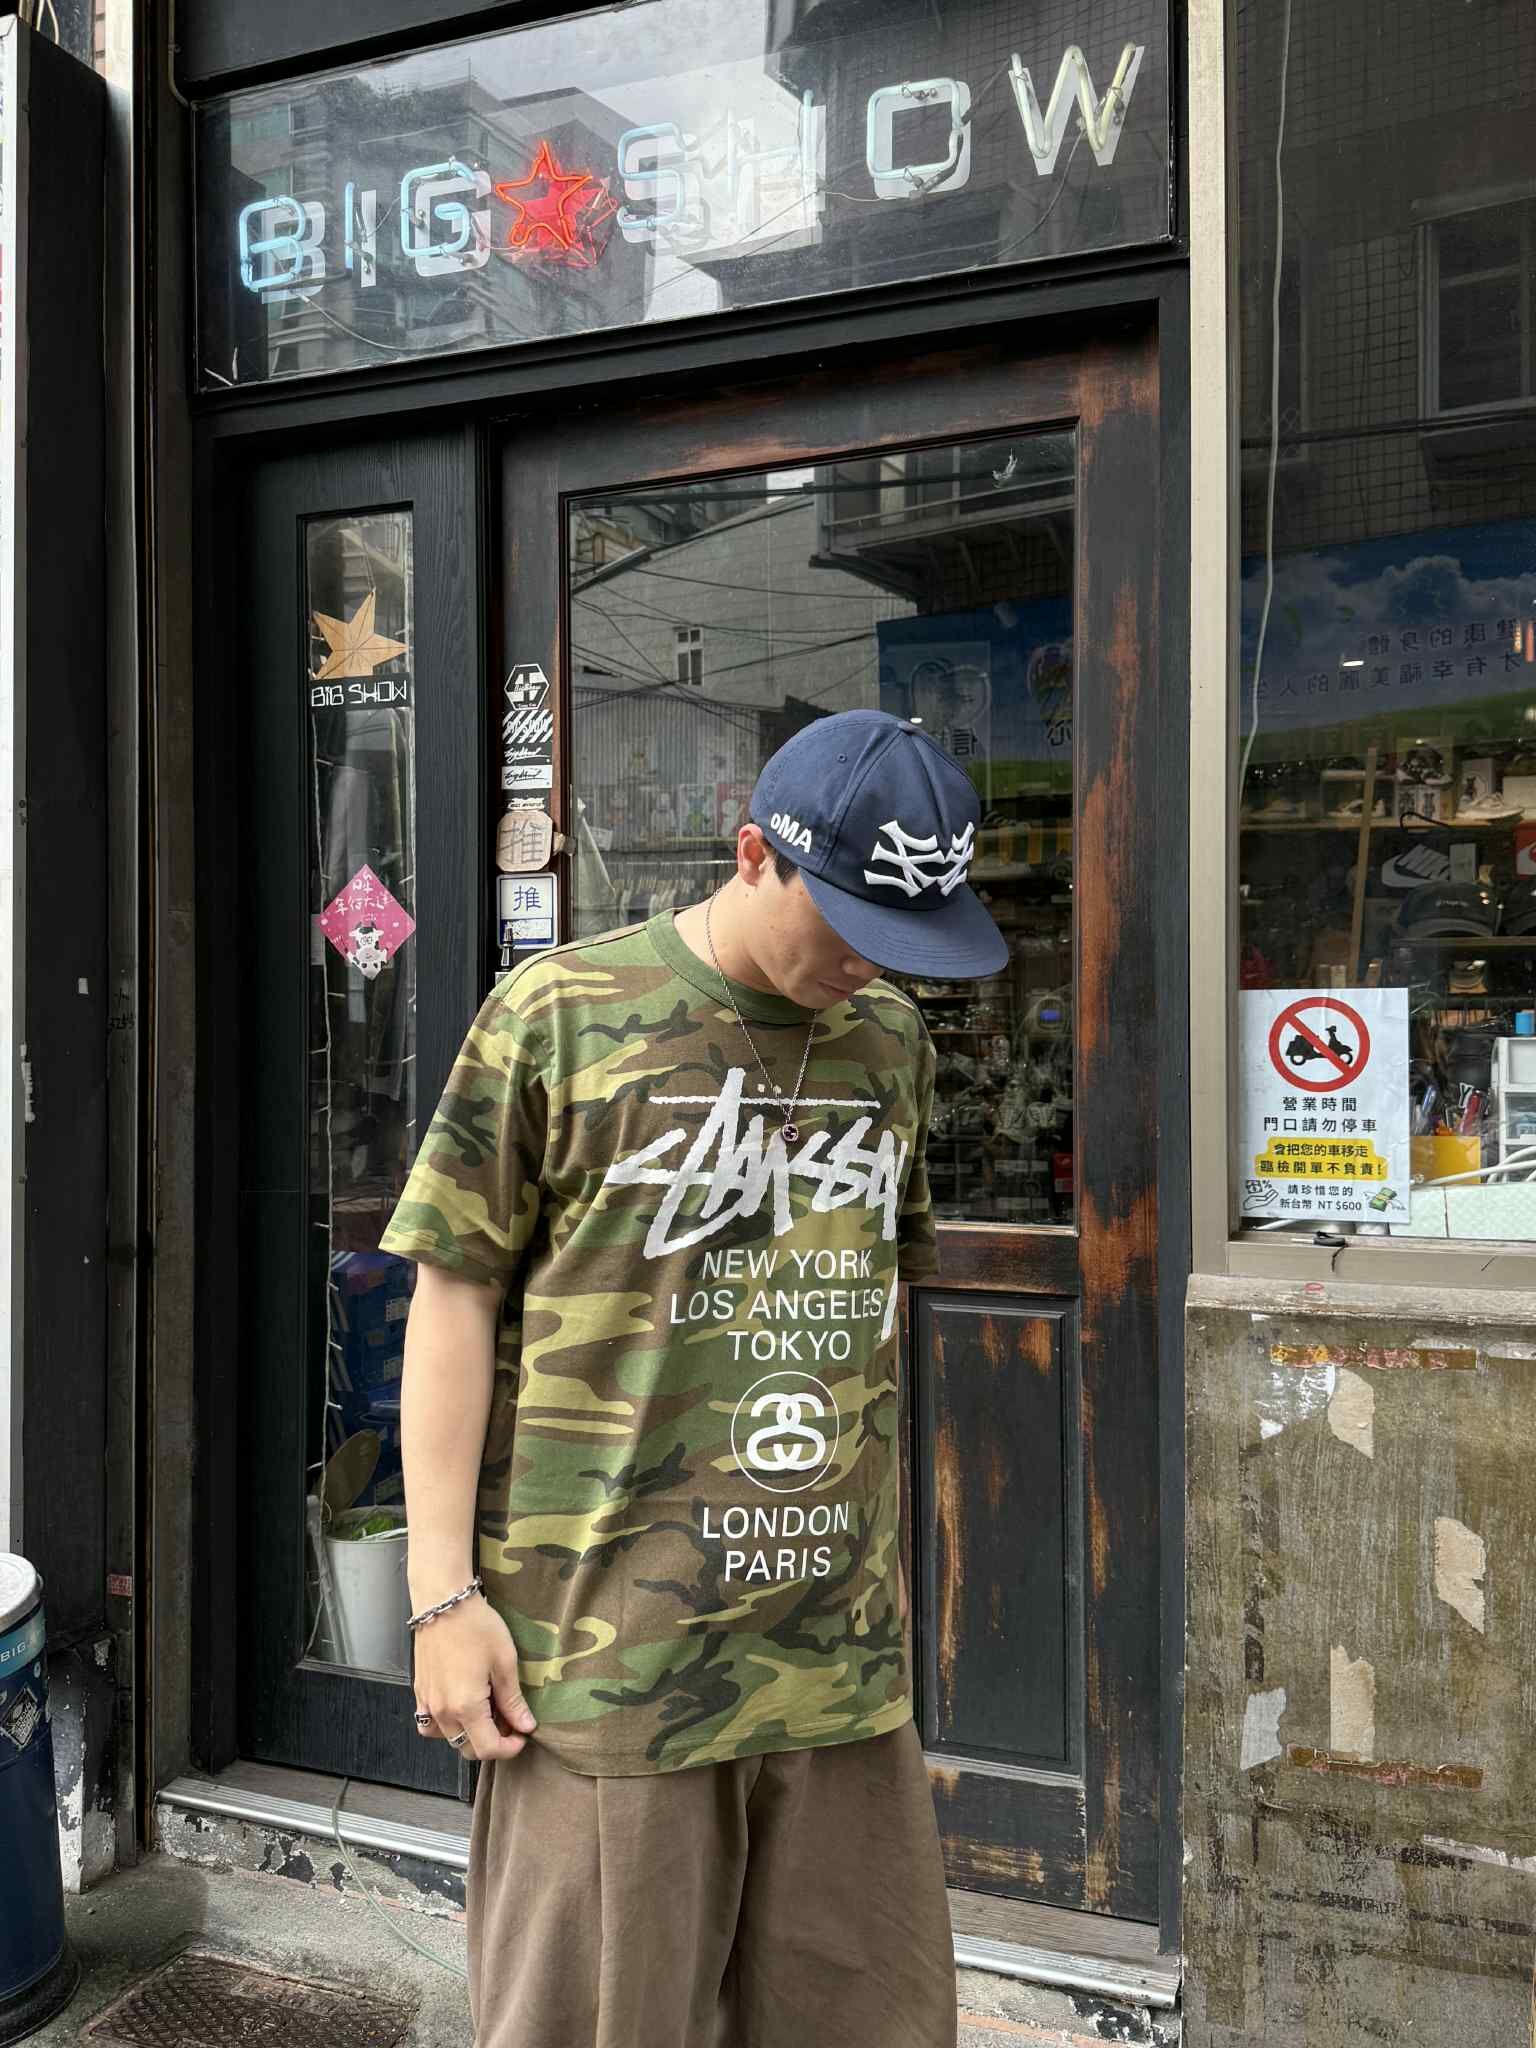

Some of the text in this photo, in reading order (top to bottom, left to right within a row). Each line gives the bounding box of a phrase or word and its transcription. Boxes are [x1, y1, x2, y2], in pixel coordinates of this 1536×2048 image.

[239, 42, 1145, 304] BIG SHOW
[349, 680, 407, 704] SHOW
[514, 886, 542, 911] 推
[1283, 1097, 1357, 1112] 營業時間
[1264, 1117, 1377, 1132] 門口請勿停車
[1274, 1144, 1368, 1157] 會把您的車移走
[1287, 1184, 1353, 1197] 請珍惜您的
[1280, 1199, 1362, 1211] 新台幣 NT $600
[702, 1249, 872, 1280] NEW YORK
[670, 1288, 883, 1324] LOS ANGELES
[727, 1330, 851, 1361] TOKYO
[702, 1501, 849, 1539] LONDON
[724, 1546, 832, 1582] PARIS
[0, 1641, 26, 1662] BIG
